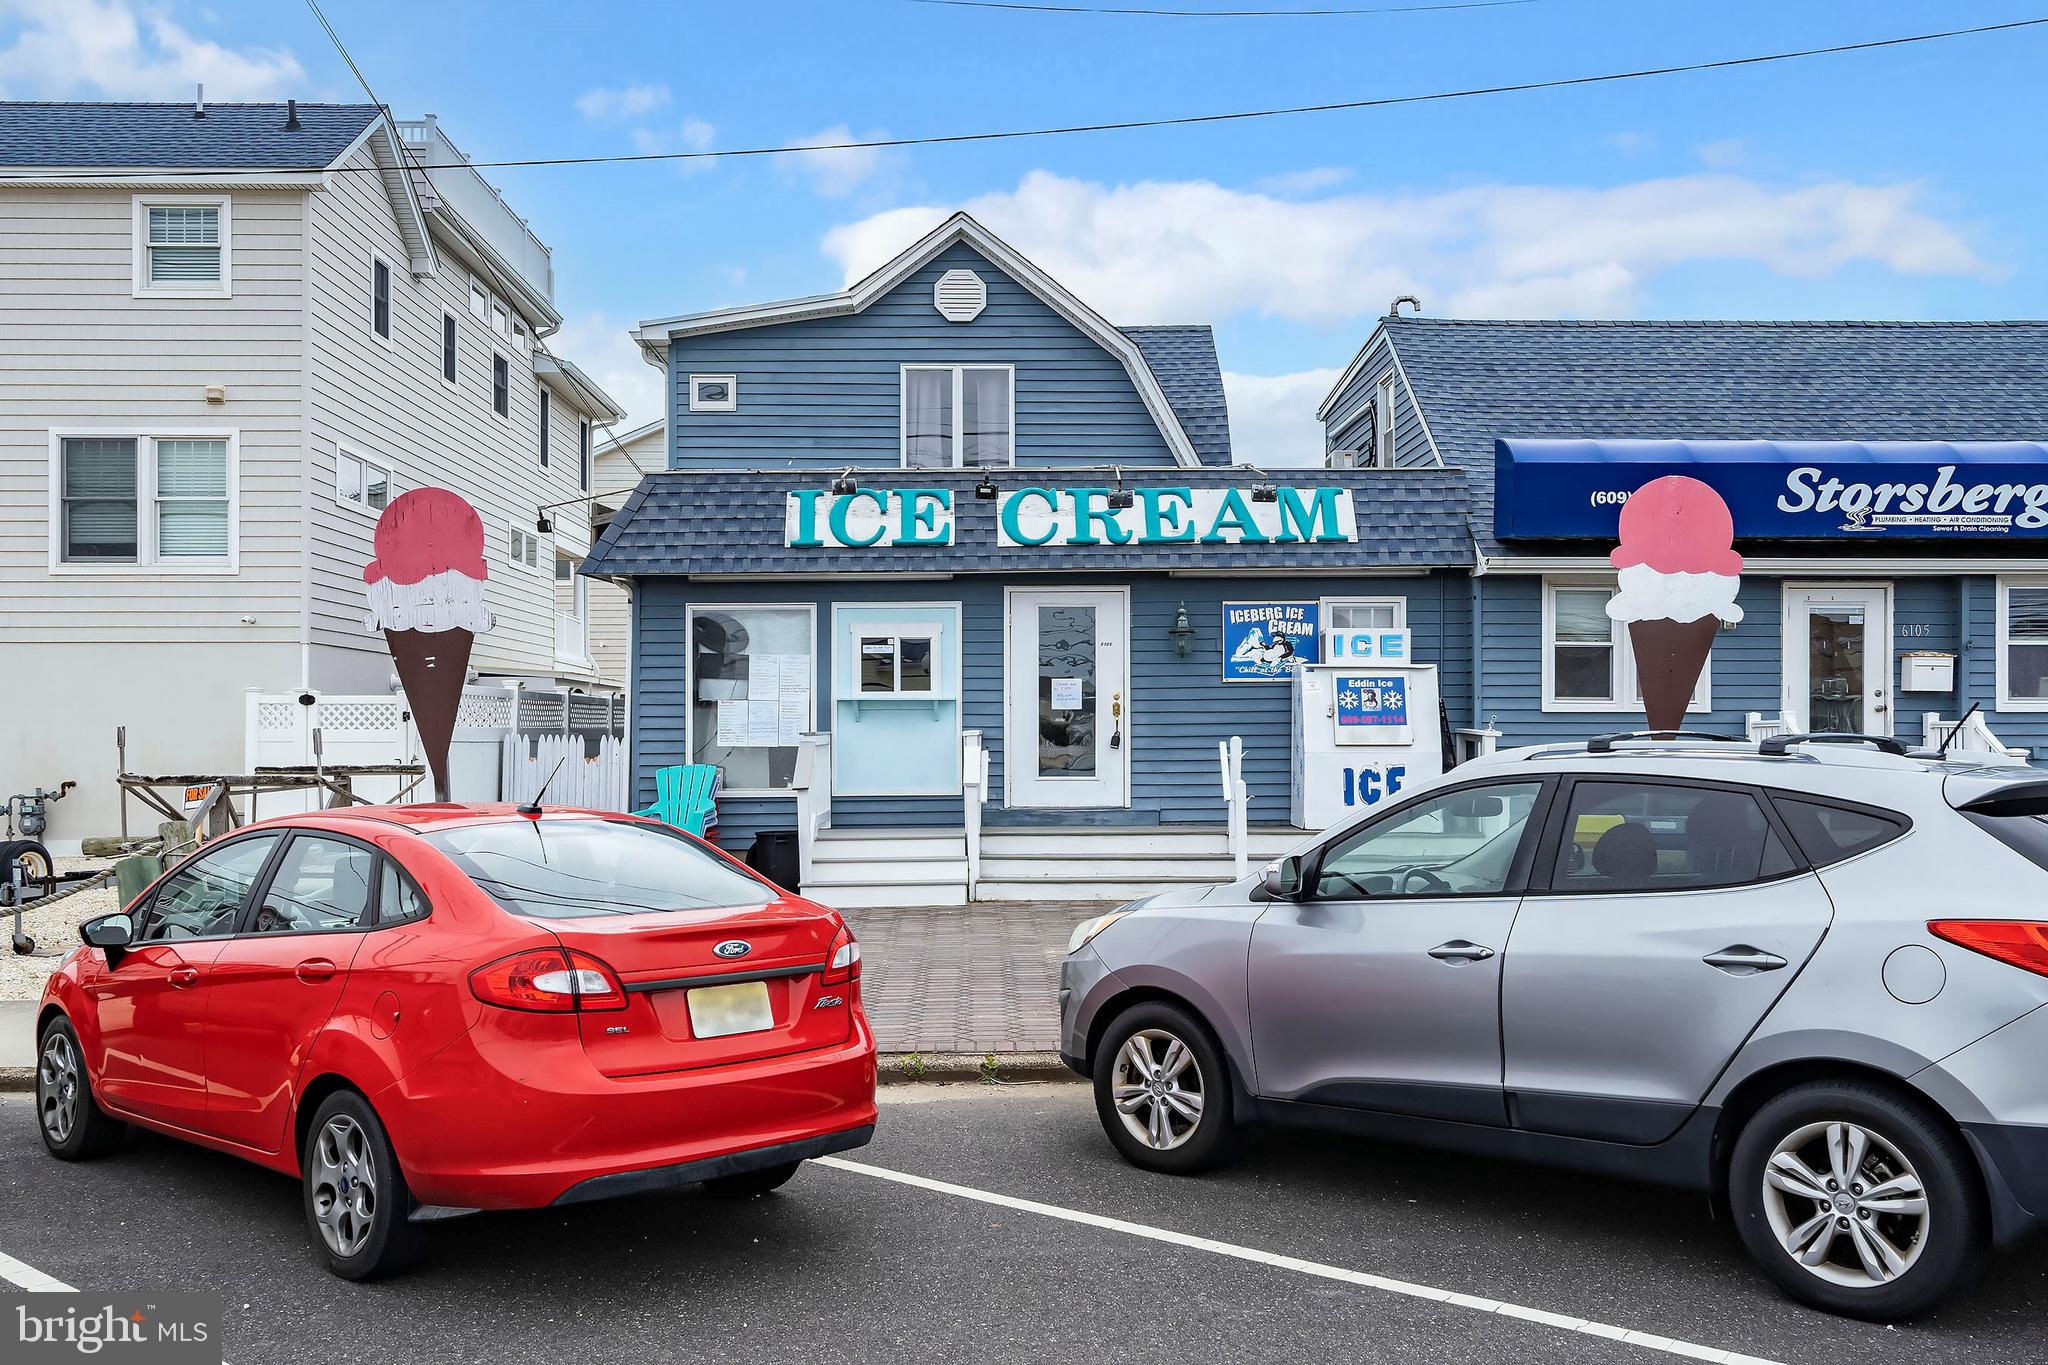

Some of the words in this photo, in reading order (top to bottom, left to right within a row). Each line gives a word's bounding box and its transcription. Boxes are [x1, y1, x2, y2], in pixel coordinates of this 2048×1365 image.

[1777, 465, 2048, 529] Storsberg
[790, 488, 951, 547] ICE
[1001, 487, 1346, 546] CREAM
[1961, 516, 2009, 524] CONDITIONING
[1229, 606, 1284, 625] ICEBERG
[1285, 606, 1305, 620] ICE
[1268, 619, 1314, 637] CREAM
[1901, 624, 1931, 637] 6105
[1333, 633, 1405, 658] ICE
[1348, 680, 1376, 688] Eddin
[1377, 680, 1394, 688] Ice
[186, 788, 198, 801] FOR
[724, 943, 745, 955] Ford
[606, 1026, 631, 1035] SEL
